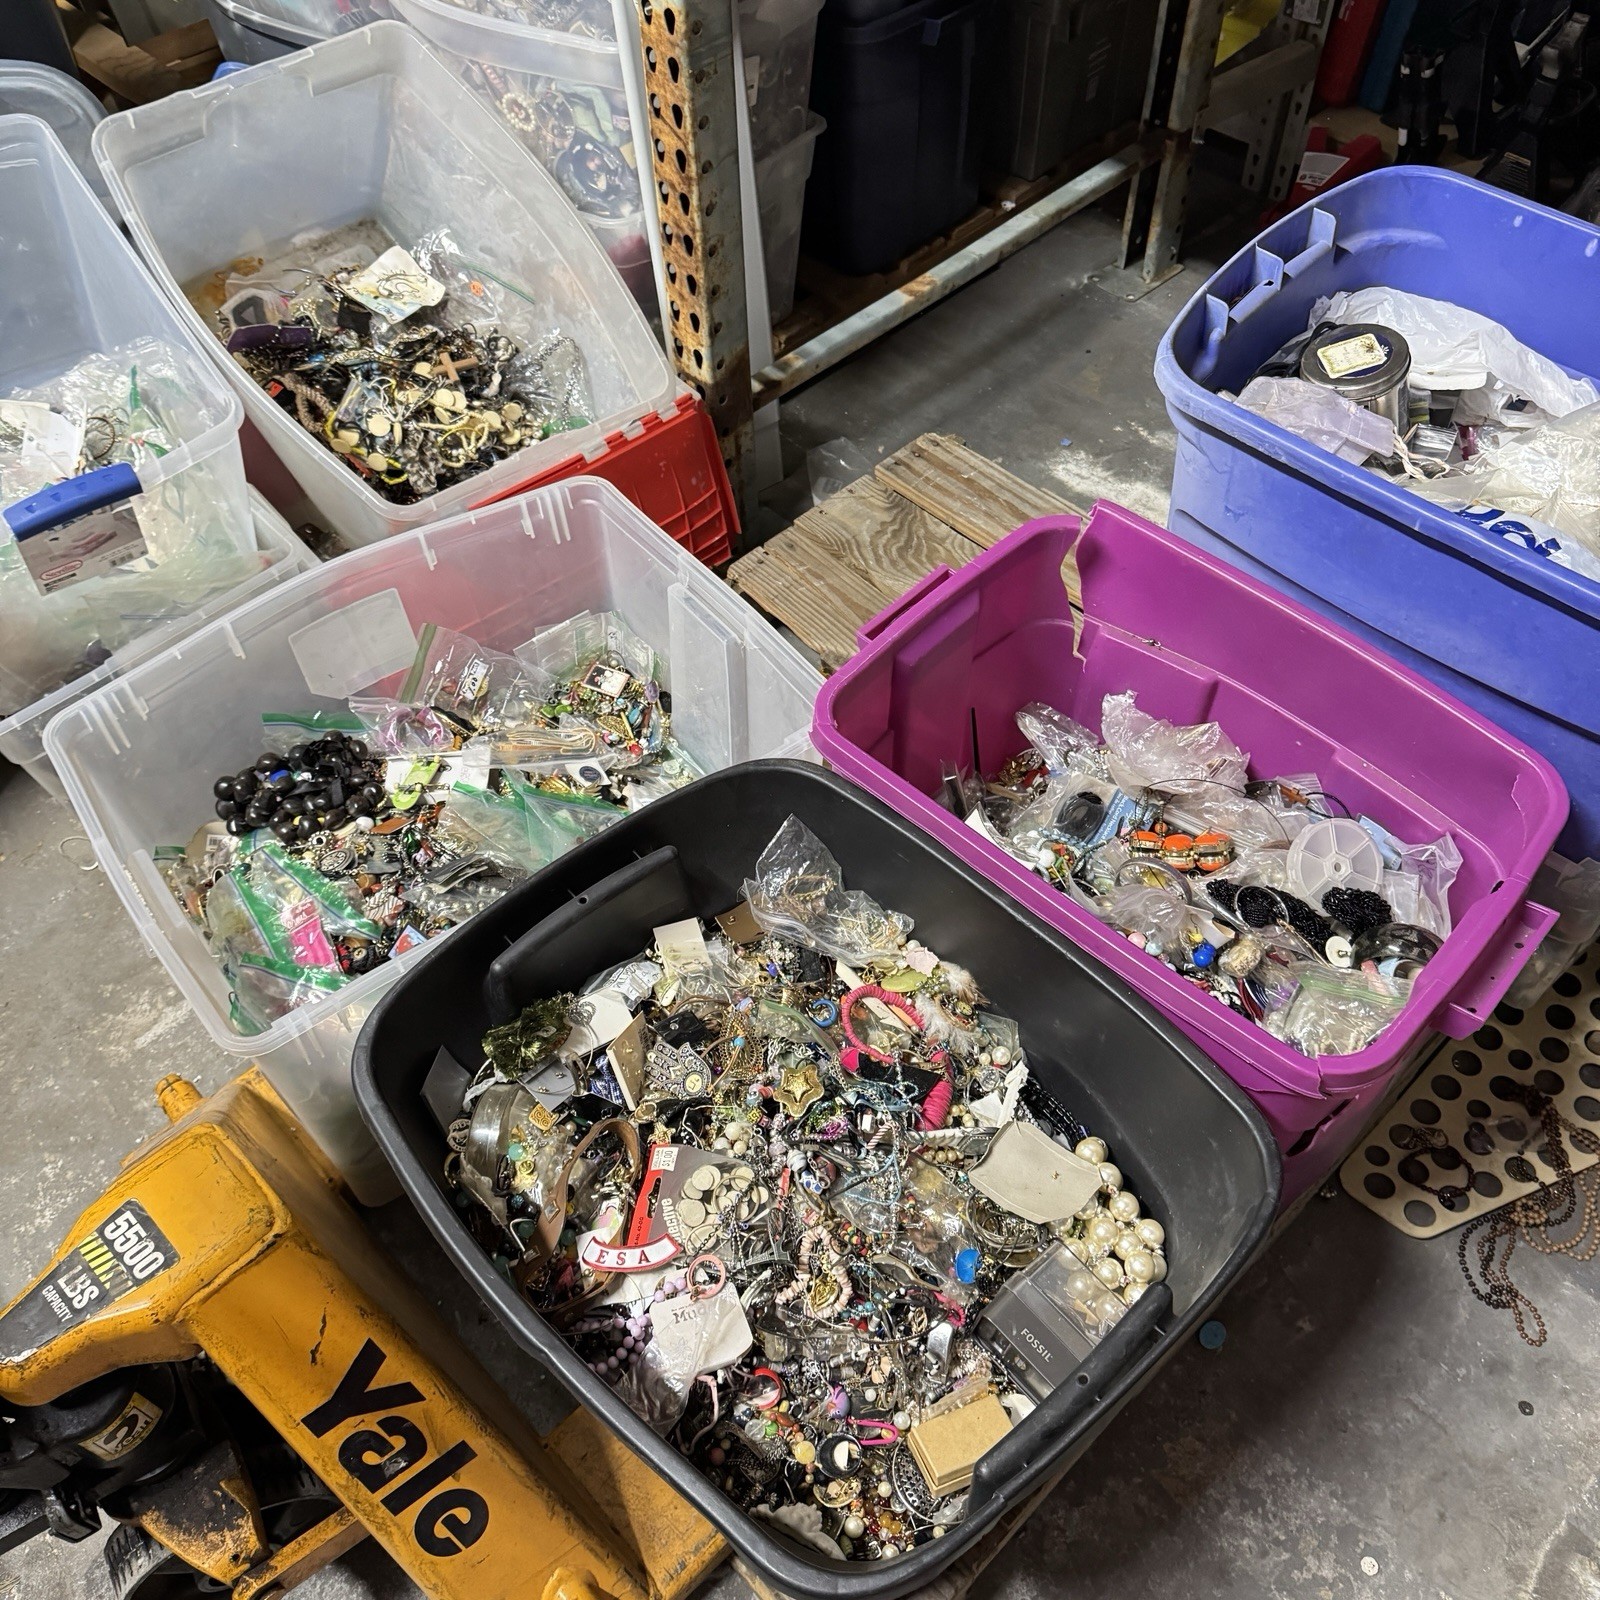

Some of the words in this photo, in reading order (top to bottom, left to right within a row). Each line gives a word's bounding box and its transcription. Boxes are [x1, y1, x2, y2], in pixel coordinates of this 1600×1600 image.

[104, 1210, 165, 1279] 5500
[42, 1285, 73, 1322] CAPACITY
[57, 1264, 99, 1309] LBS
[1020, 1328, 1051, 1362] FOSSIL
[300, 1337, 490, 1558] Yale
